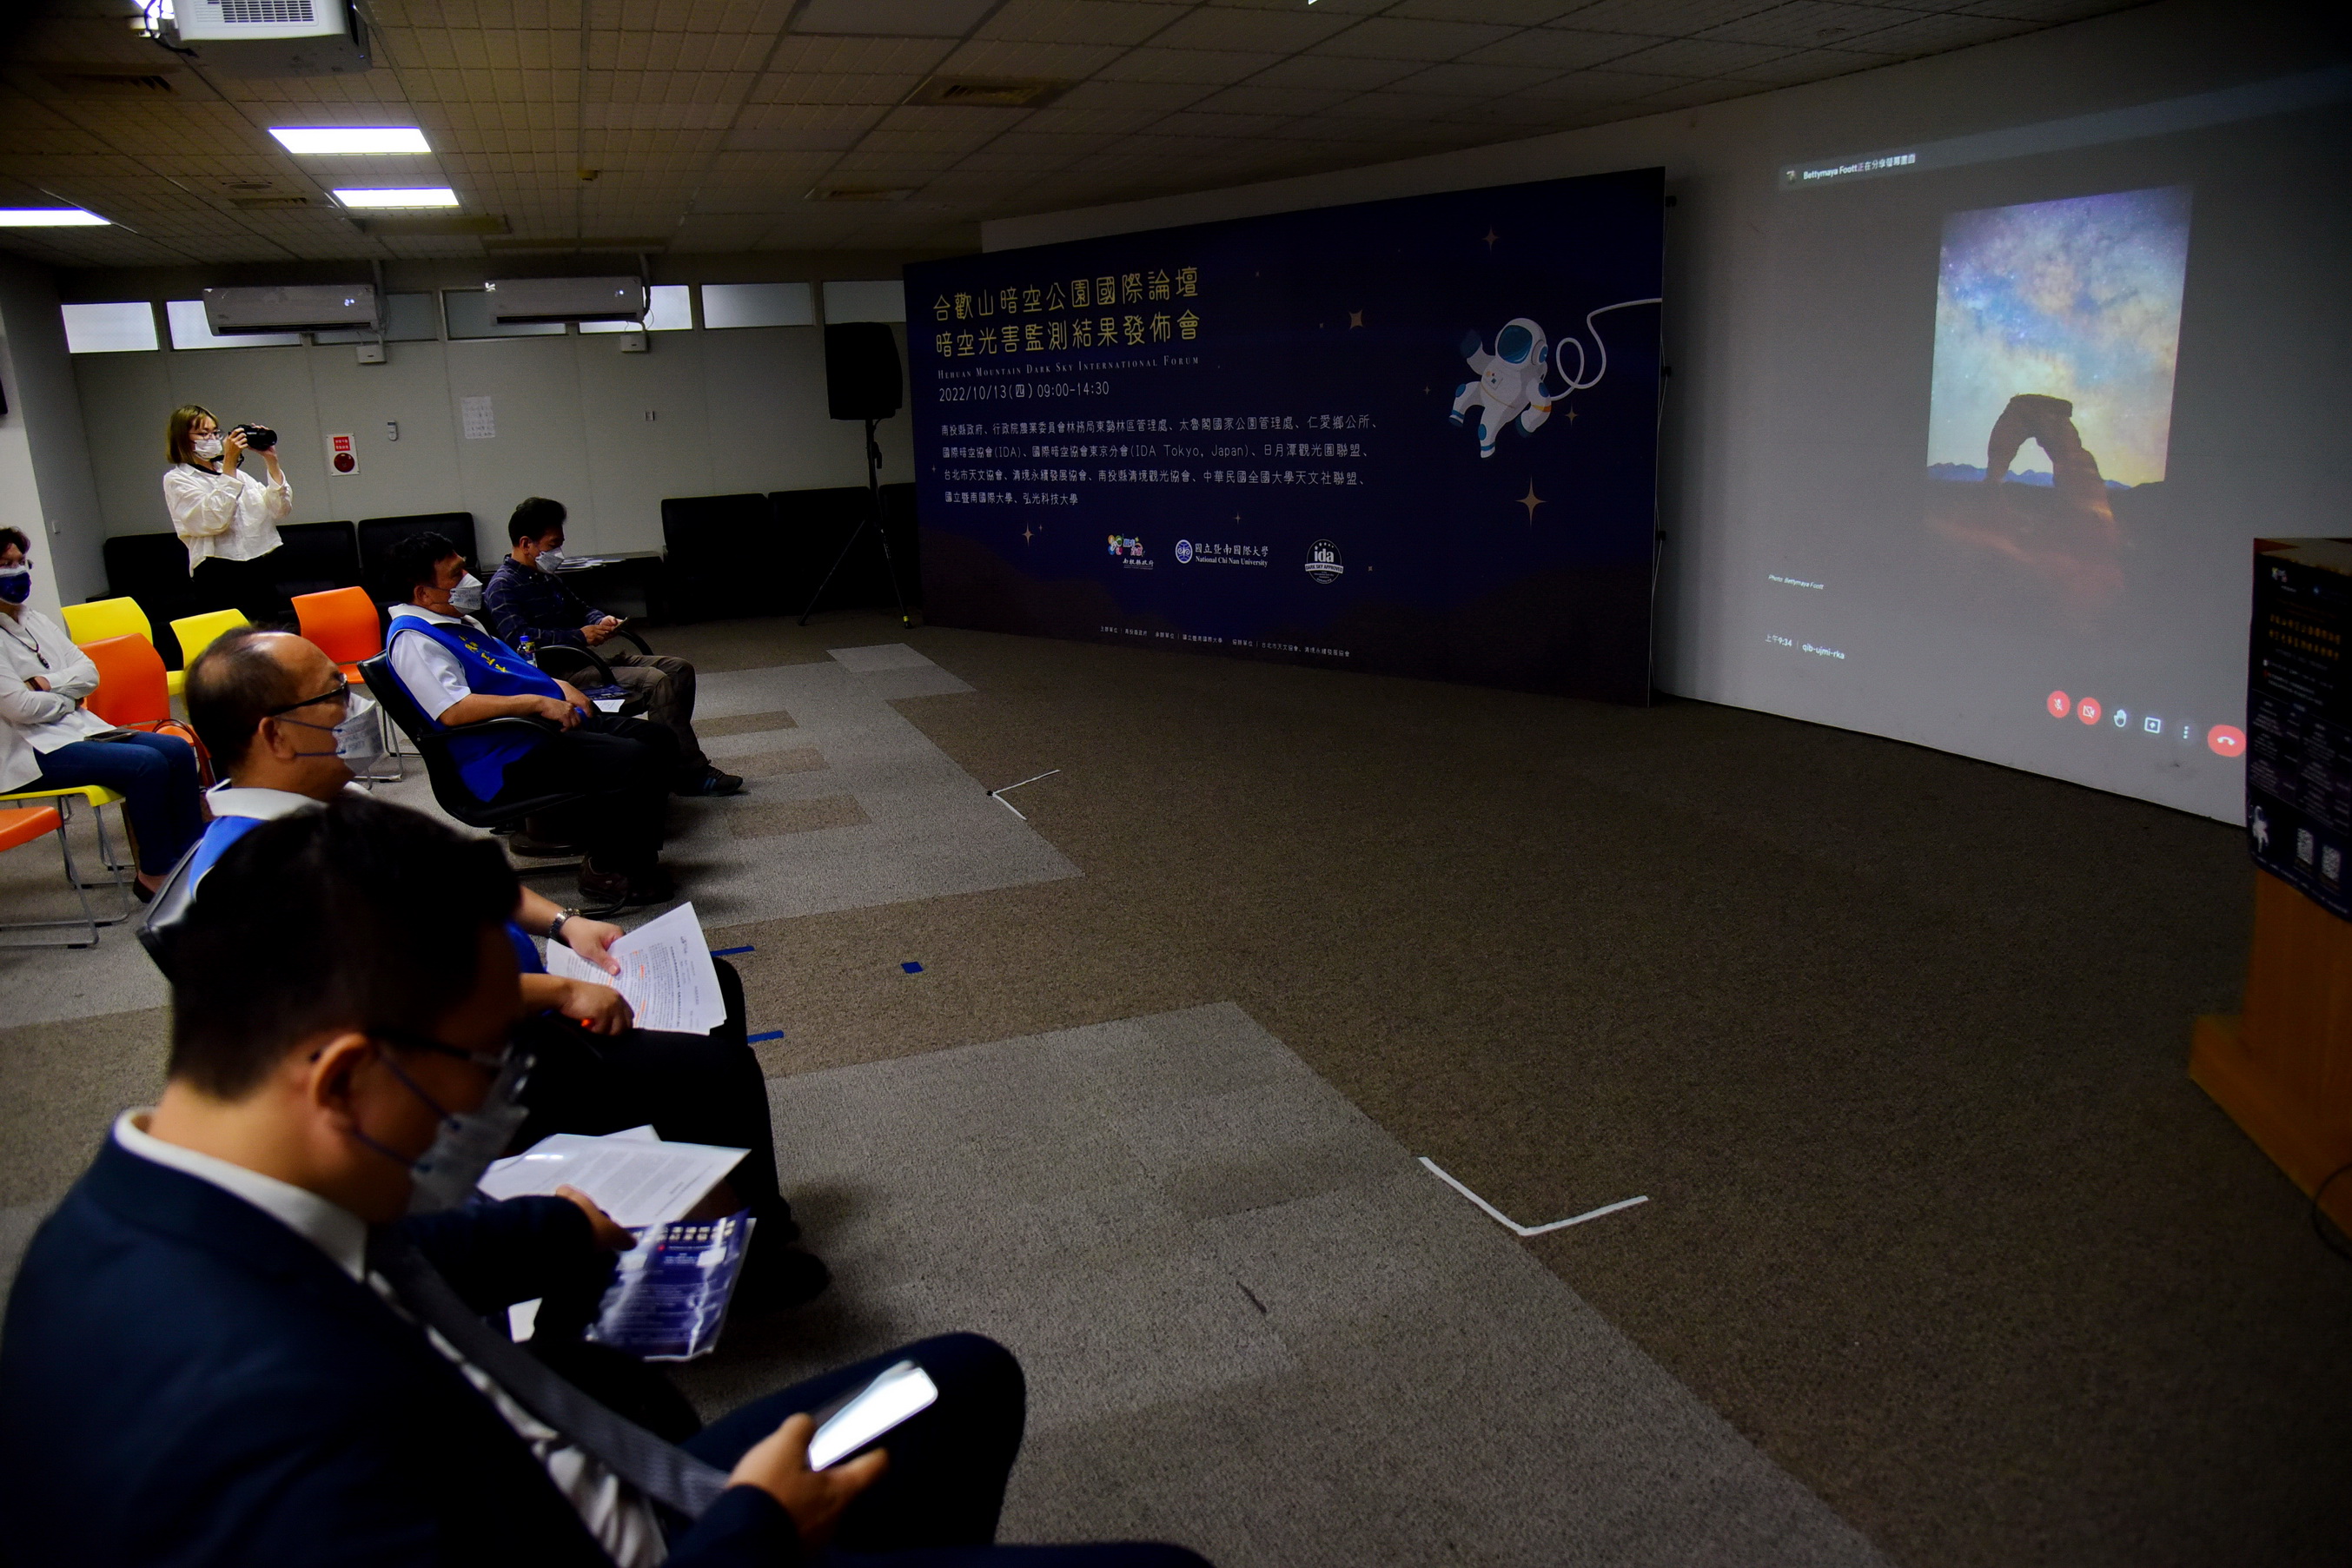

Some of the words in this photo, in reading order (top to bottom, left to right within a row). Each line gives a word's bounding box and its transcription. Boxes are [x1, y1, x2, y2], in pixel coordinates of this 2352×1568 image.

[1803, 168, 1839, 180] Bettymaya
[932, 266, 1199, 321] 合歡山暗空公園國際論壇
[936, 308, 1200, 358] 暗空光害監測結果發佈會
[1163, 445, 1204, 459] Tokyo,
[1314, 545, 1335, 563] ida
[1241, 558, 1268, 567] University
